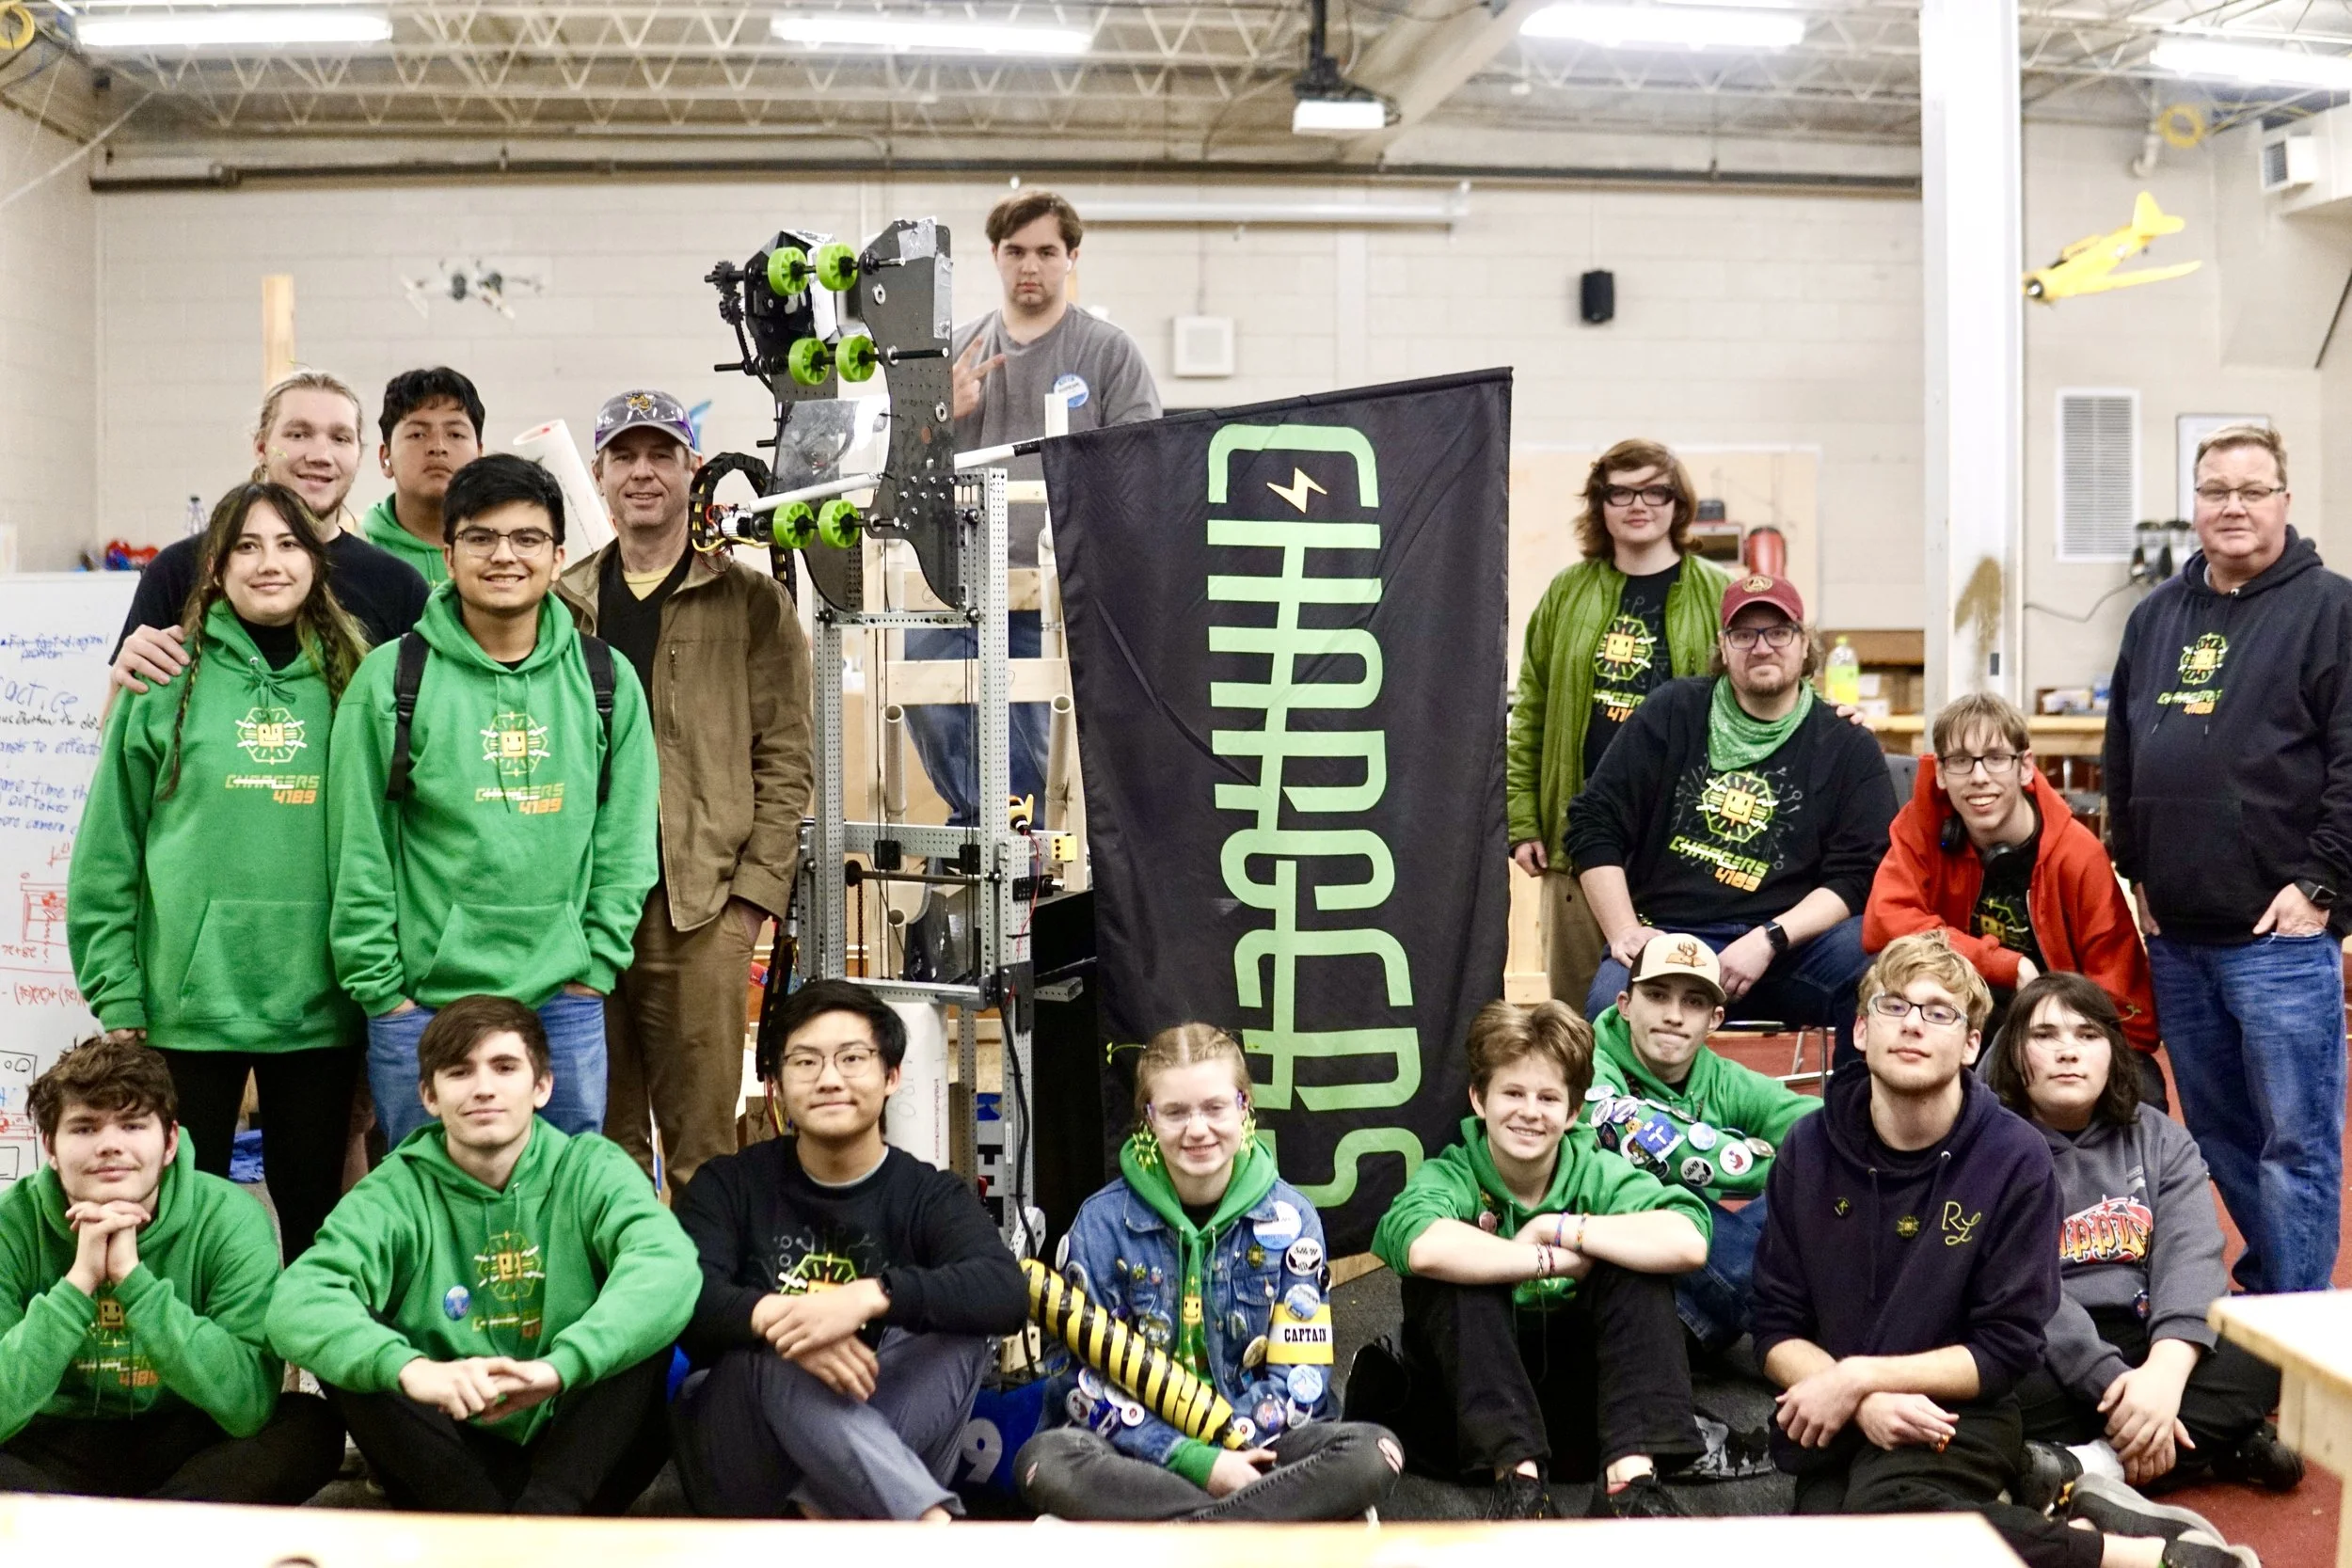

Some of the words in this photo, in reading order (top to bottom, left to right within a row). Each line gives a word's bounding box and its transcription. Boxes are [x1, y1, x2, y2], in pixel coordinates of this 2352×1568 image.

[1607, 706, 1633, 722] 41
[225, 775, 320, 789] CHARGERS
[273, 789, 317, 804] 4189
[474, 783, 565, 802] CHARGERS
[518, 798, 563, 815] 4189
[1207, 423, 1425, 1209] CHARGERS
[1669, 836, 1770, 876] CHARGERS
[1714, 867, 1762, 892] 4189
[1283, 1327, 1327, 1342] CAPTAIN
